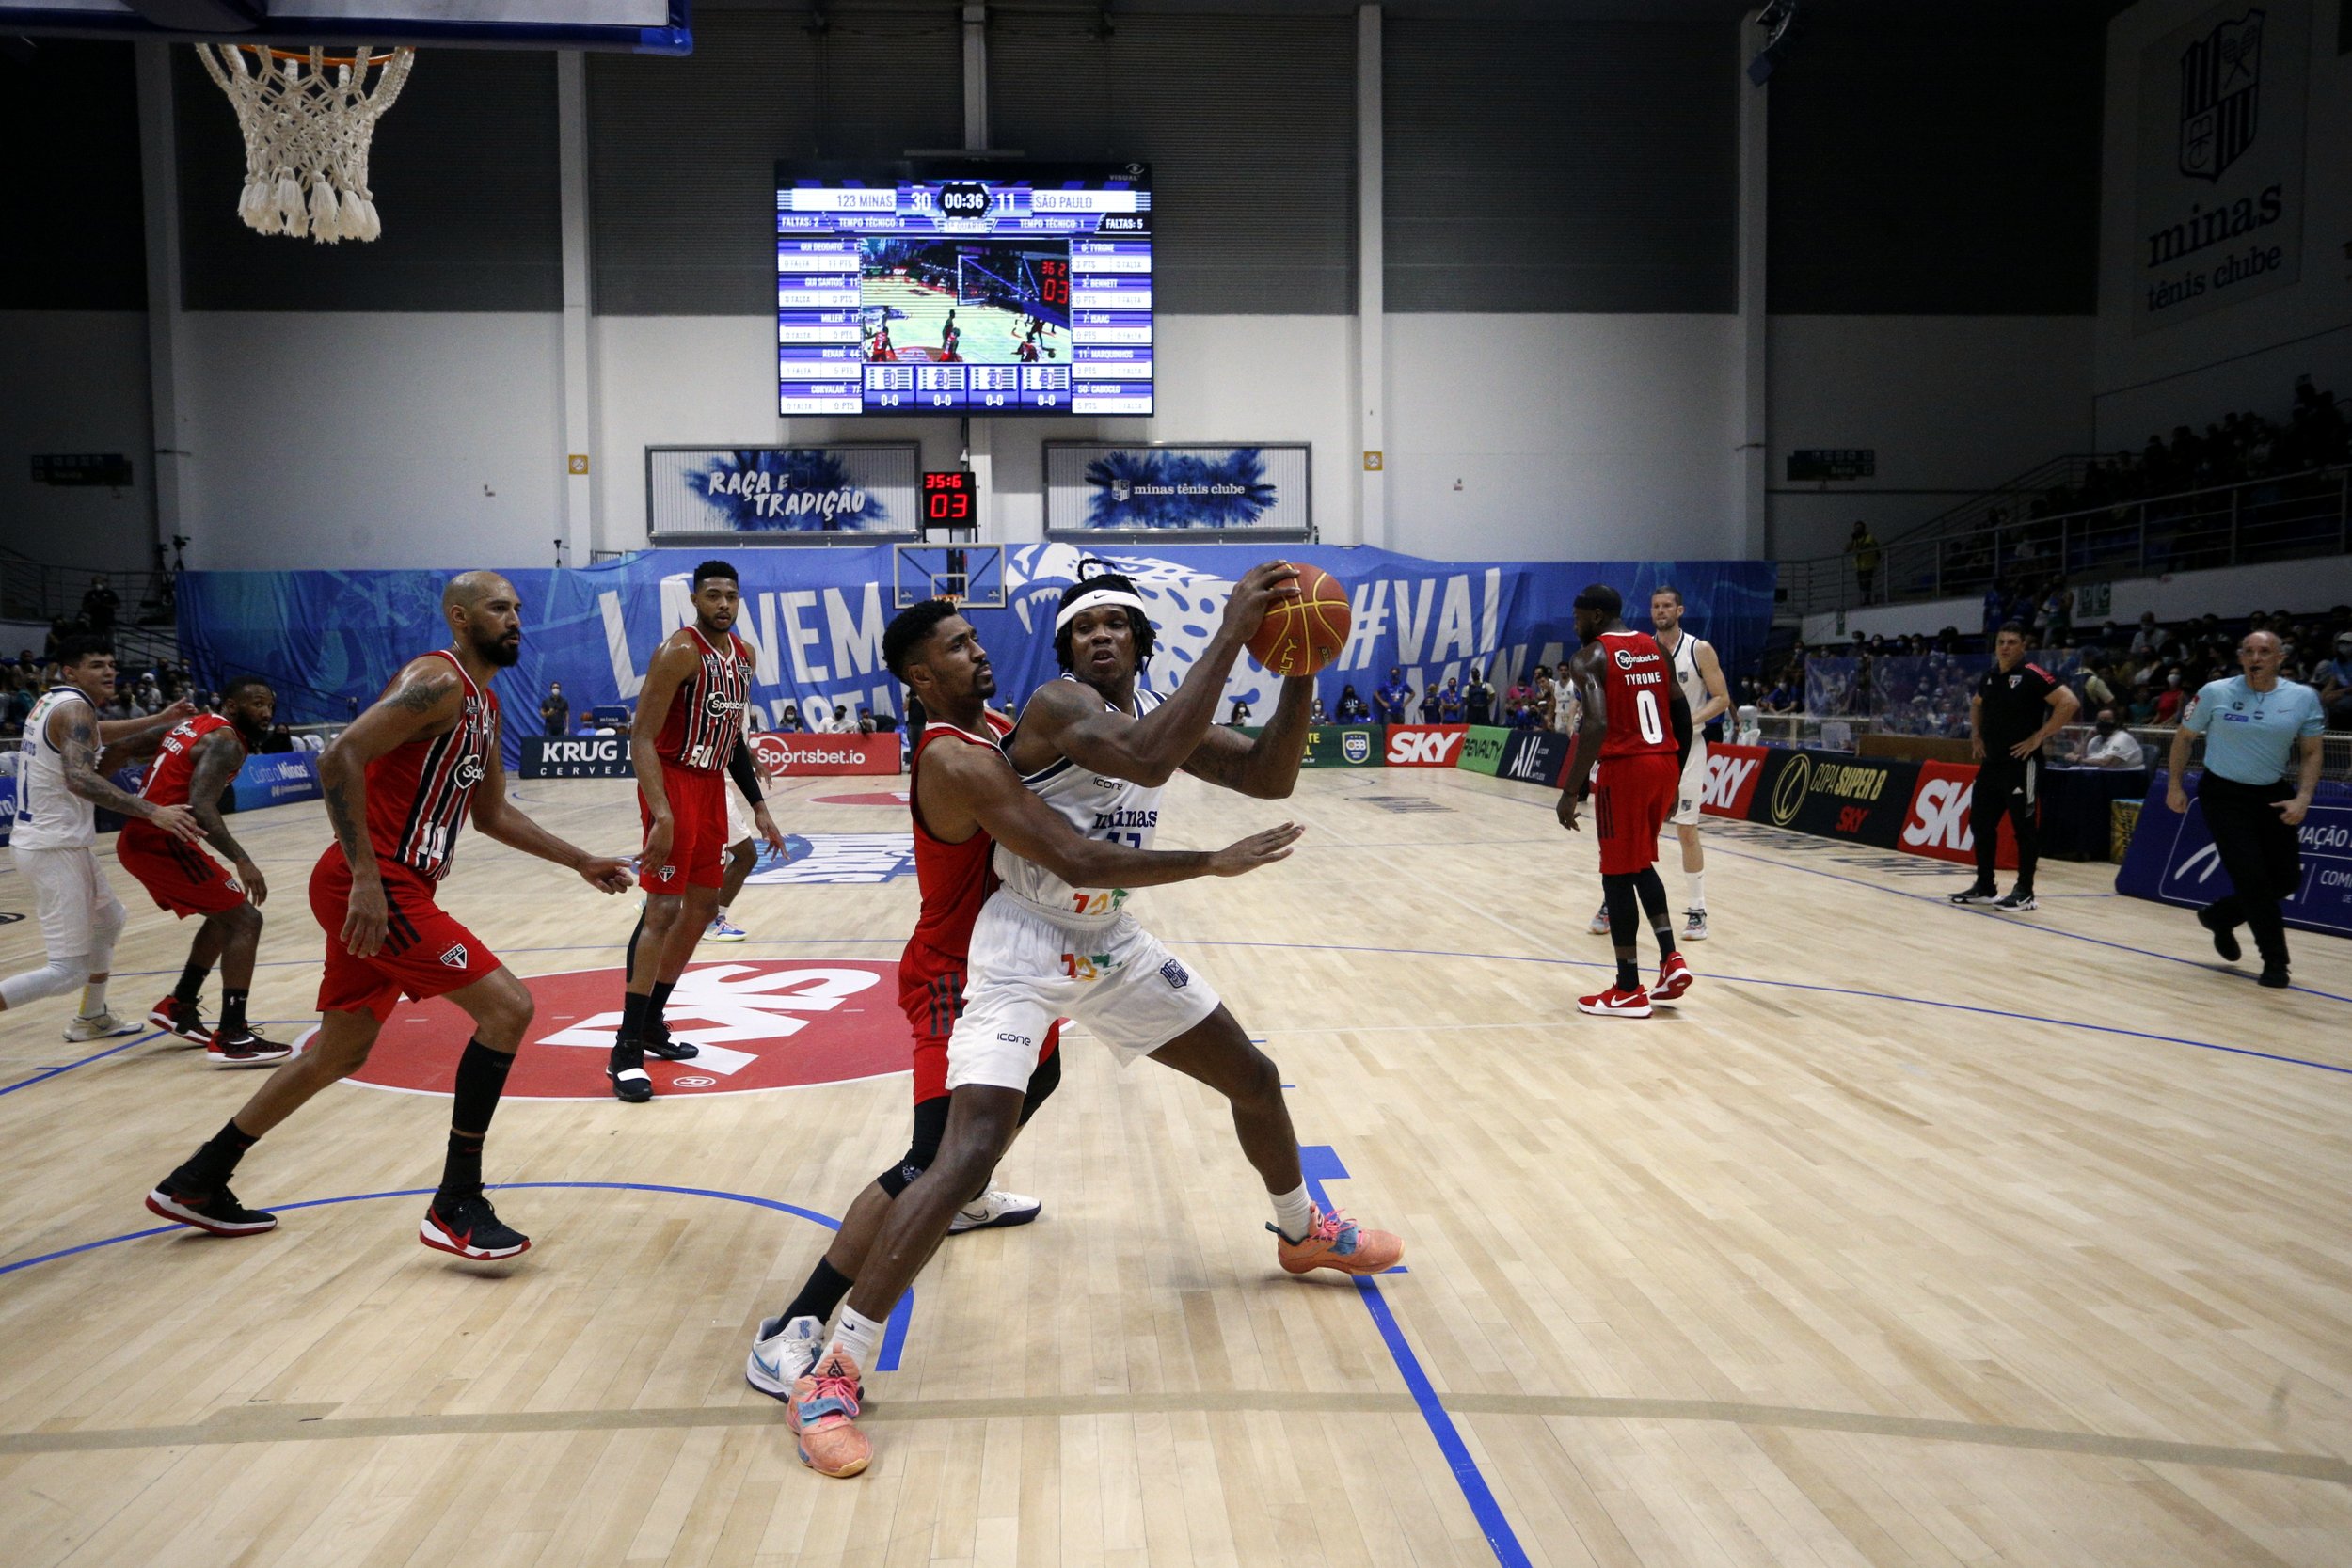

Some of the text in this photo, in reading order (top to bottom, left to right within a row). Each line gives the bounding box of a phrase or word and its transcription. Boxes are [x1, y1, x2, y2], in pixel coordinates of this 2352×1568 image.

[837, 195, 893, 208] 123 MINAS
[911, 192, 931, 211] 30
[944, 192, 984, 210] 00:36
[997, 193, 1015, 211] 11
[1036, 194, 1092, 208] SÃO PAULO
[781, 217, 819, 227] FALTAS: 2
[838, 215, 905, 228] TEMPO TÉCNICO: 0
[1019, 219, 1043, 229] TEMPO
[1045, 217, 1077, 229] TÉCNICO:
[1105, 218, 1143, 229] FALTAS: 5
[2147, 183, 2282, 268] minas
[840, 260, 852, 268] PTS
[1083, 261, 1096, 269] PTS
[2146, 245, 2281, 312] tênis clube
[1043, 278, 1069, 304] 03
[881, 394, 898, 406] 0-0
[934, 394, 952, 406] 0-0
[986, 394, 1004, 406] 0-0
[1038, 394, 1056, 406] 0-0
[708, 470, 789, 501] RAÇA E
[1134, 483, 1246, 495] minas tênis clube
[754, 483, 866, 521] TRADIÇÃO
[930, 493, 968, 518] 03
[1337, 567, 1500, 671] #VAI
[1625, 672, 1661, 686] TYRONE
[1636, 690, 1663, 744] 0
[542, 740, 618, 763] KRUG
[687, 745, 713, 768] 50
[1387, 732, 1461, 763] SKY
[1463, 738, 1503, 762] PENALTY
[757, 749, 866, 768] Sportsbet.io
[1701, 754, 1756, 809] SKY
[1810, 763, 1887, 800] COPA SUPER 8
[1092, 806, 1158, 829] minas
[1836, 806, 1867, 833] SKY
[417, 821, 447, 861] 11
[443, 947, 464, 961] SPFC
[534, 964, 881, 1076] SKY
